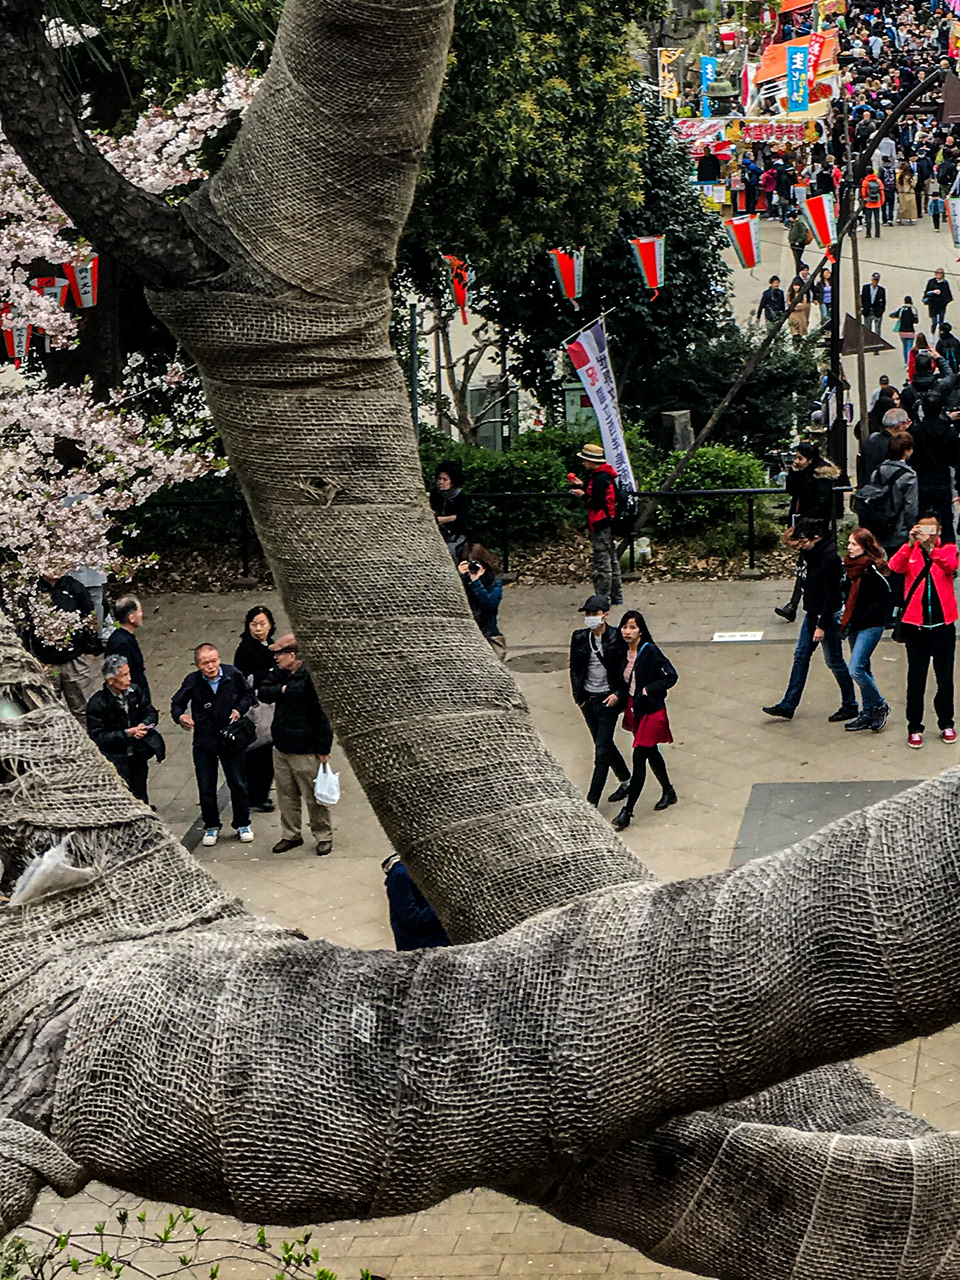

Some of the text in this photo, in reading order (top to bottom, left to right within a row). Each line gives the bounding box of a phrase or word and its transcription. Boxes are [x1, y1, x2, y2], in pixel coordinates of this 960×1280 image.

[742, 123, 807, 141] 大盛やきそば
